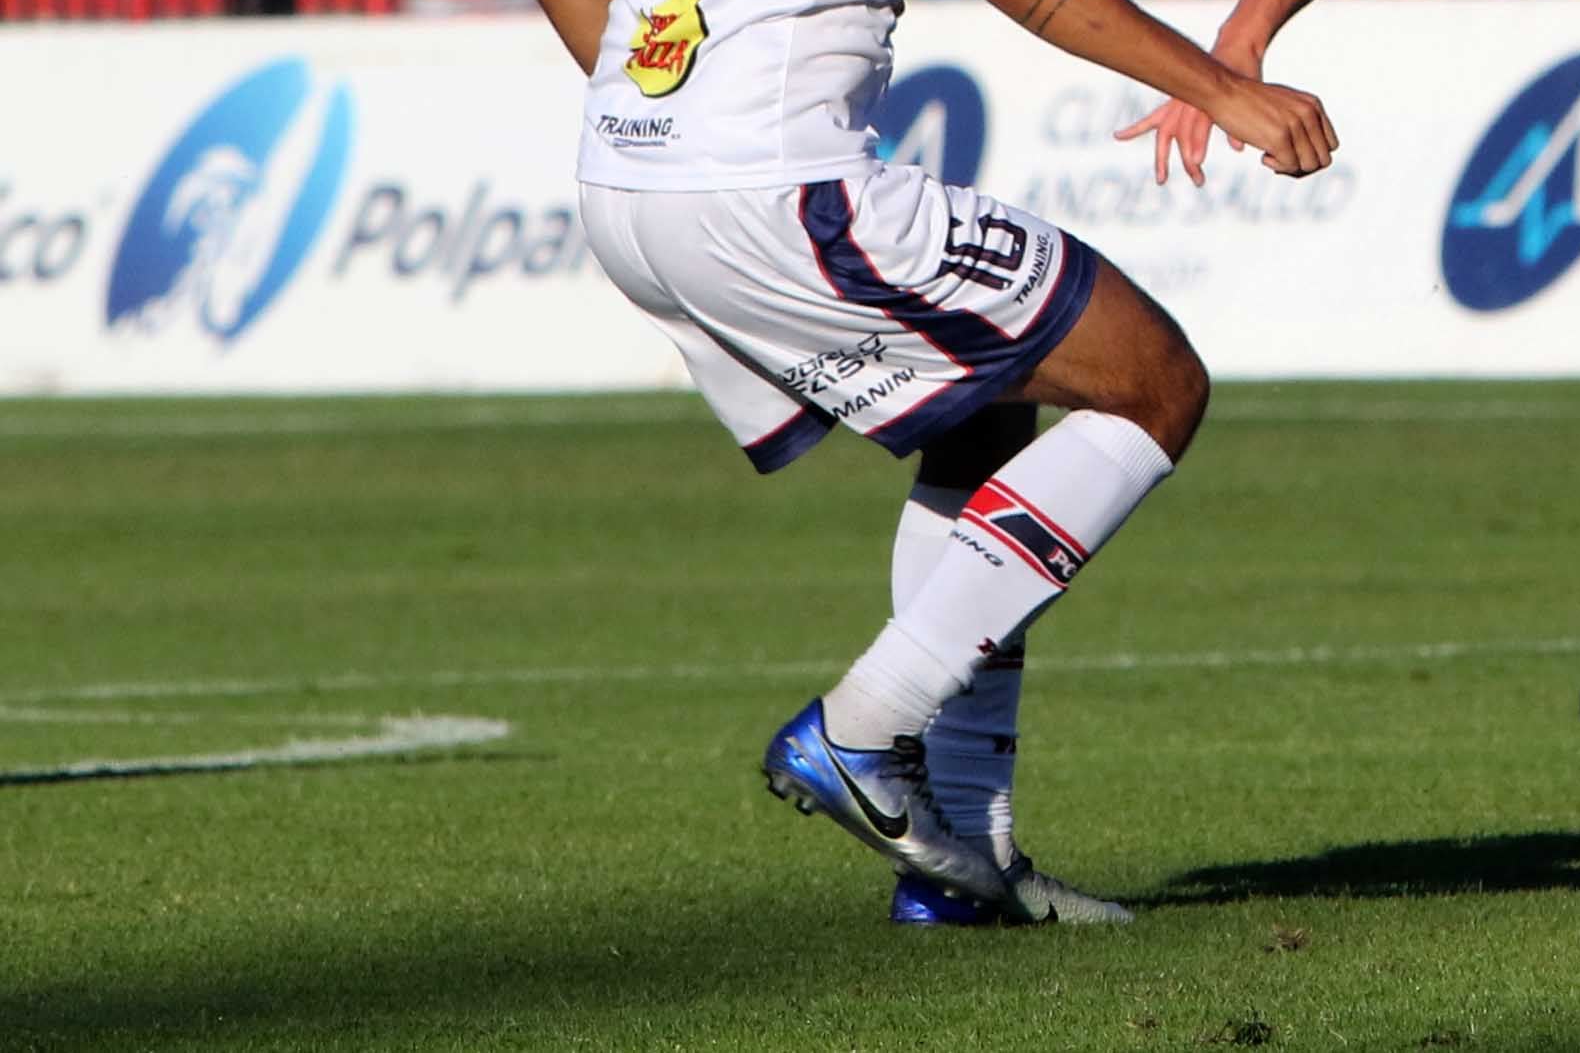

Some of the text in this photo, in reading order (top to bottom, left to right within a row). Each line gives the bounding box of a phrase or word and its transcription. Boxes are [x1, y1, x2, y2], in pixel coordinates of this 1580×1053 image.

[596, 114, 674, 139] TRAINING
[335, 182, 590, 304] Polpa
[1014, 233, 1049, 305] TRAINING
